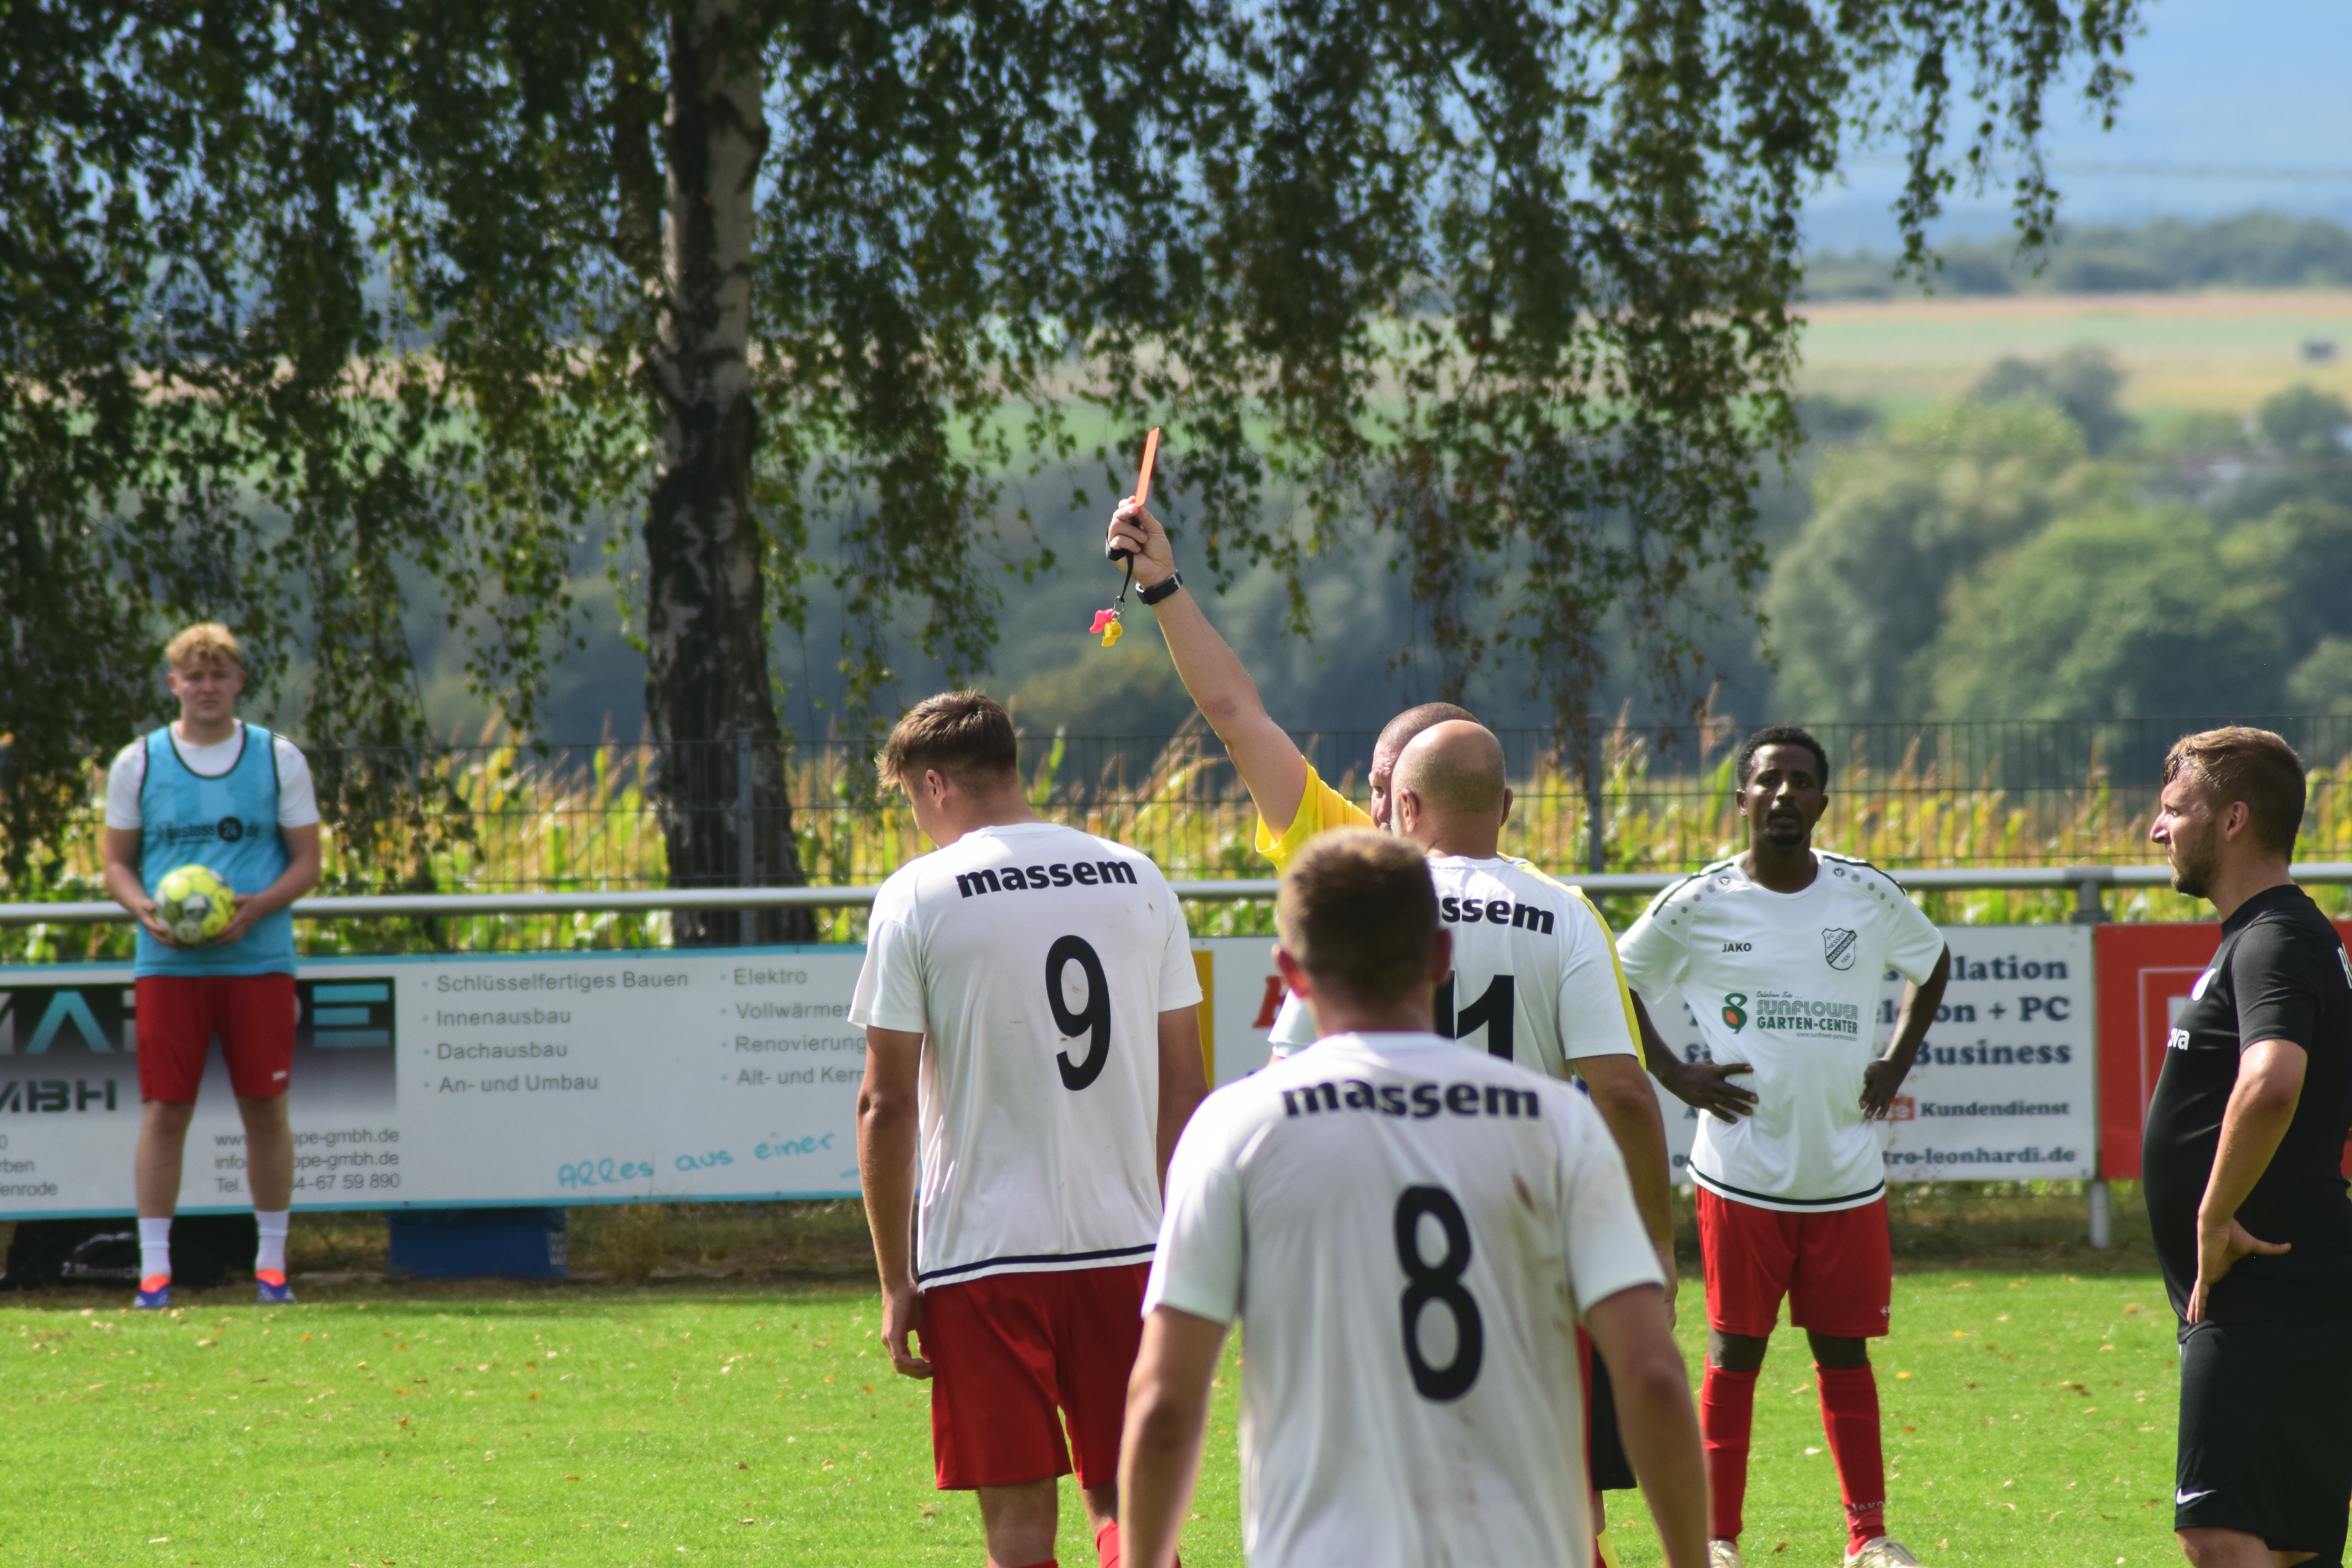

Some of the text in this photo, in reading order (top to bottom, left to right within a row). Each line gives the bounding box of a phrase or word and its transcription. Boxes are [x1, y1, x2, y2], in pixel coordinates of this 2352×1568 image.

[955, 861, 1138, 898] massem
[1442, 897, 1555, 935] ssem
[1722, 943, 1752, 953] JAKO
[1827, 932, 1845, 950] HESSEN
[1828, 933, 1855, 962] MASSENHEIM
[733, 968, 808, 985] Elektro
[1947, 955, 2068, 980] lation
[436, 971, 689, 993] Schlüsselfertiges Bauen
[437, 1007, 572, 1026] Innenausbau
[1045, 935, 1111, 1091] 9
[1756, 1000, 1858, 1019] SUNFLOWER
[2018, 996, 2070, 1022] PC
[1756, 1016, 1857, 1035] GARTEN-CENTER
[437, 1042, 568, 1060] Dachausbau
[1913, 1039, 2071, 1065] Business
[439, 1074, 598, 1093] An- und Umbau
[737, 1068, 772, 1085] Alt-
[777, 1066, 814, 1085] und
[1282, 1078, 1539, 1118] massem
[1921, 1100, 2070, 1116] Kundendienst
[557, 1132, 835, 1188] Alles aus einer
[0, 1181, 58, 1196] enrode
[215, 1177, 243, 1193] Tel.
[343, 1174, 364, 1189] 59
[369, 1173, 400, 1189] 890
[1394, 1184, 1484, 1401] 8
